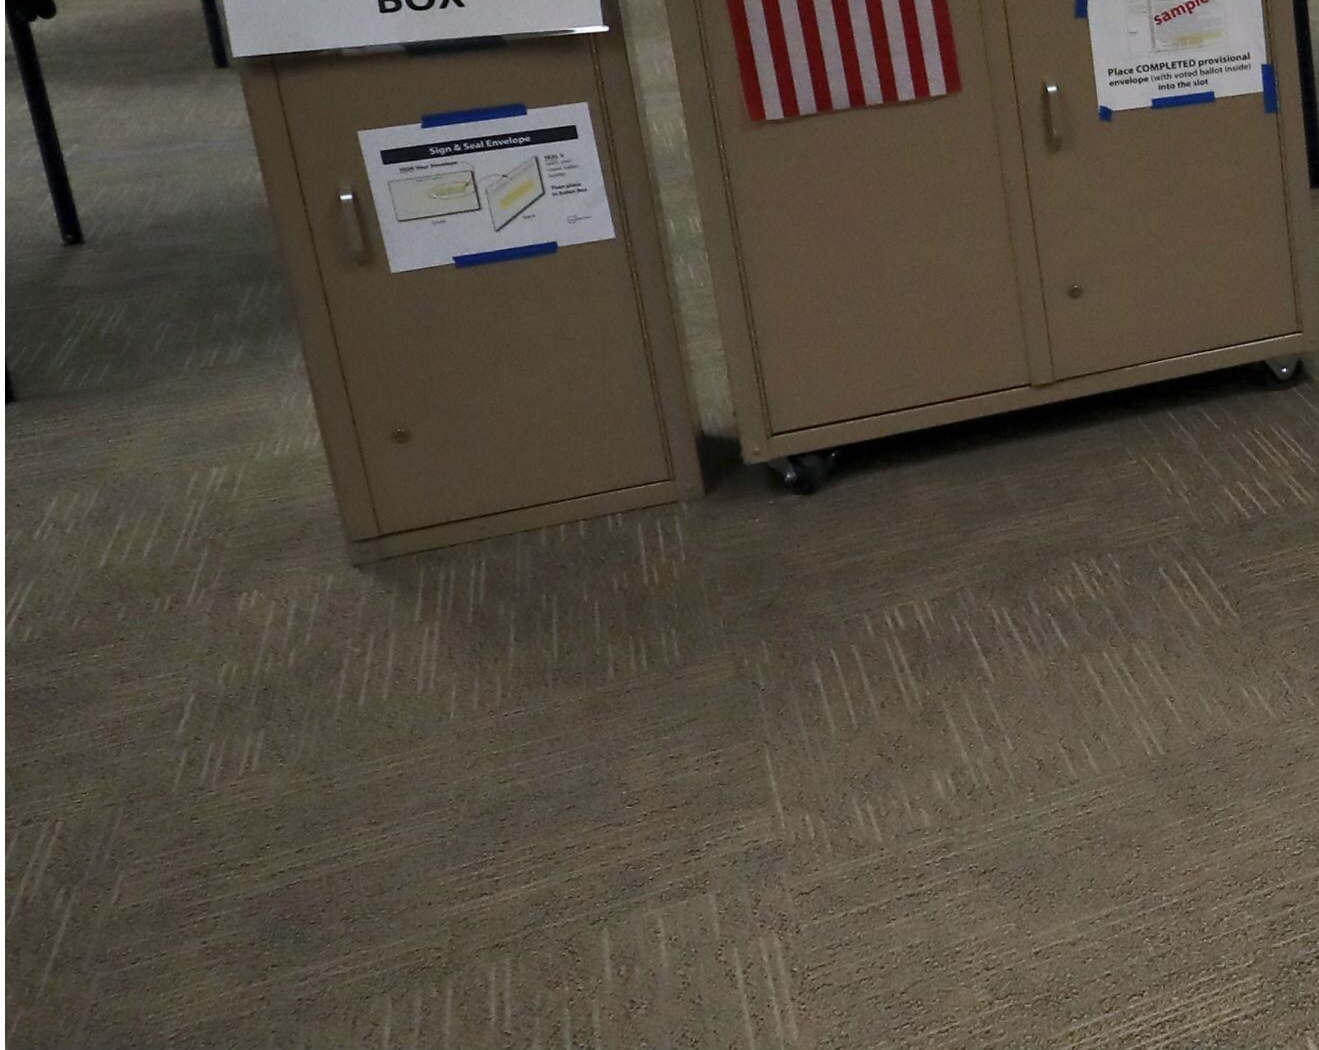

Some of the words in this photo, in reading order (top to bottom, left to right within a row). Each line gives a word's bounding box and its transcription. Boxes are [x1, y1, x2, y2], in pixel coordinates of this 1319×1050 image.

[1107, 67, 1134, 77] Place
[1136, 59, 1196, 73] COMPLETED
[1198, 52, 1251, 68] provisional
[1108, 75, 1149, 87] envelope
[1151, 71, 1173, 83] (with
[1174, 70, 1198, 79] voted
[1200, 66, 1223, 76] ballot
[1225, 63, 1252, 73] inside)
[1158, 82, 1176, 91] into
[1177, 81, 1191, 89] the
[1193, 78, 1209, 87] slot
[429, 146, 452, 156] Sign
[463, 141, 485, 150] Seal
[486, 136, 531, 148] Envelope
